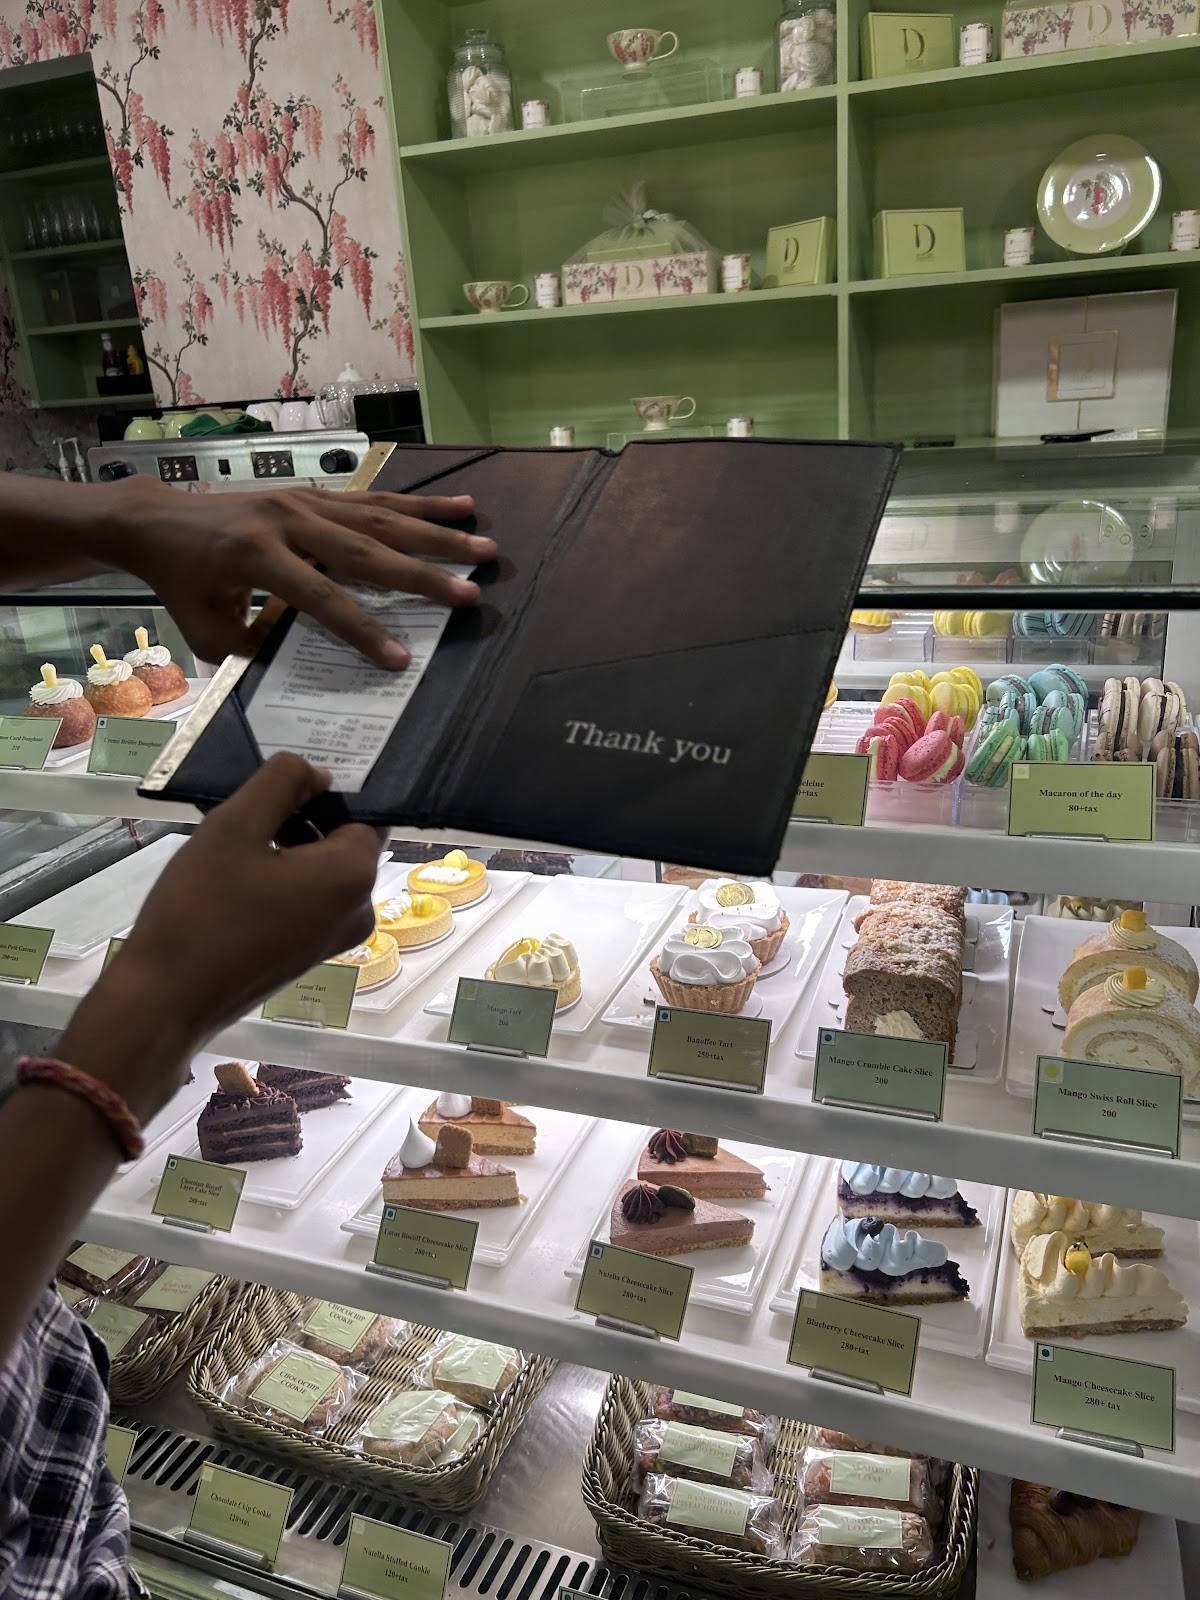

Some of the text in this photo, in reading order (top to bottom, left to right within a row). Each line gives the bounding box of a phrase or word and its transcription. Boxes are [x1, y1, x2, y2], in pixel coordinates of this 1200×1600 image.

[900, 28, 925, 60] D
[784, 236, 800, 264] D
[912, 223, 935, 253] D
[623, 264, 645, 291] D
[565, 719, 731, 764] Thank you
[1040, 789, 1077, 797] Macaron
[1091, 790, 1104, 798] the
[1106, 791, 1123, 800] day
[1068, 804, 1098, 812] 80+tax
[687, 1036, 733, 1048] Banoffee Tart
[829, 1056, 933, 1077] Mango Crumble Cake Slice
[1058, 1087, 1158, 1109] Mango Swiss Roll Slice
[1101, 1109, 1117, 1118] 200
[622, 1275, 657, 1292] Cheesecake
[659, 1287, 674, 1297] Slice
[806, 1317, 904, 1350] Blueberry Cheesecake Slice
[840, 1341, 869, 1355] 280+tax
[1053, 1374, 1156, 1402] Mango Cheesecake Slice
[1085, 1396, 1121, 1411] 280+ tax
[210, 1492, 238, 1508] Chocolate
[252, 1507, 272, 1520] Cookie
[363, 1547, 430, 1575] Nutella Stuffed Cookie
